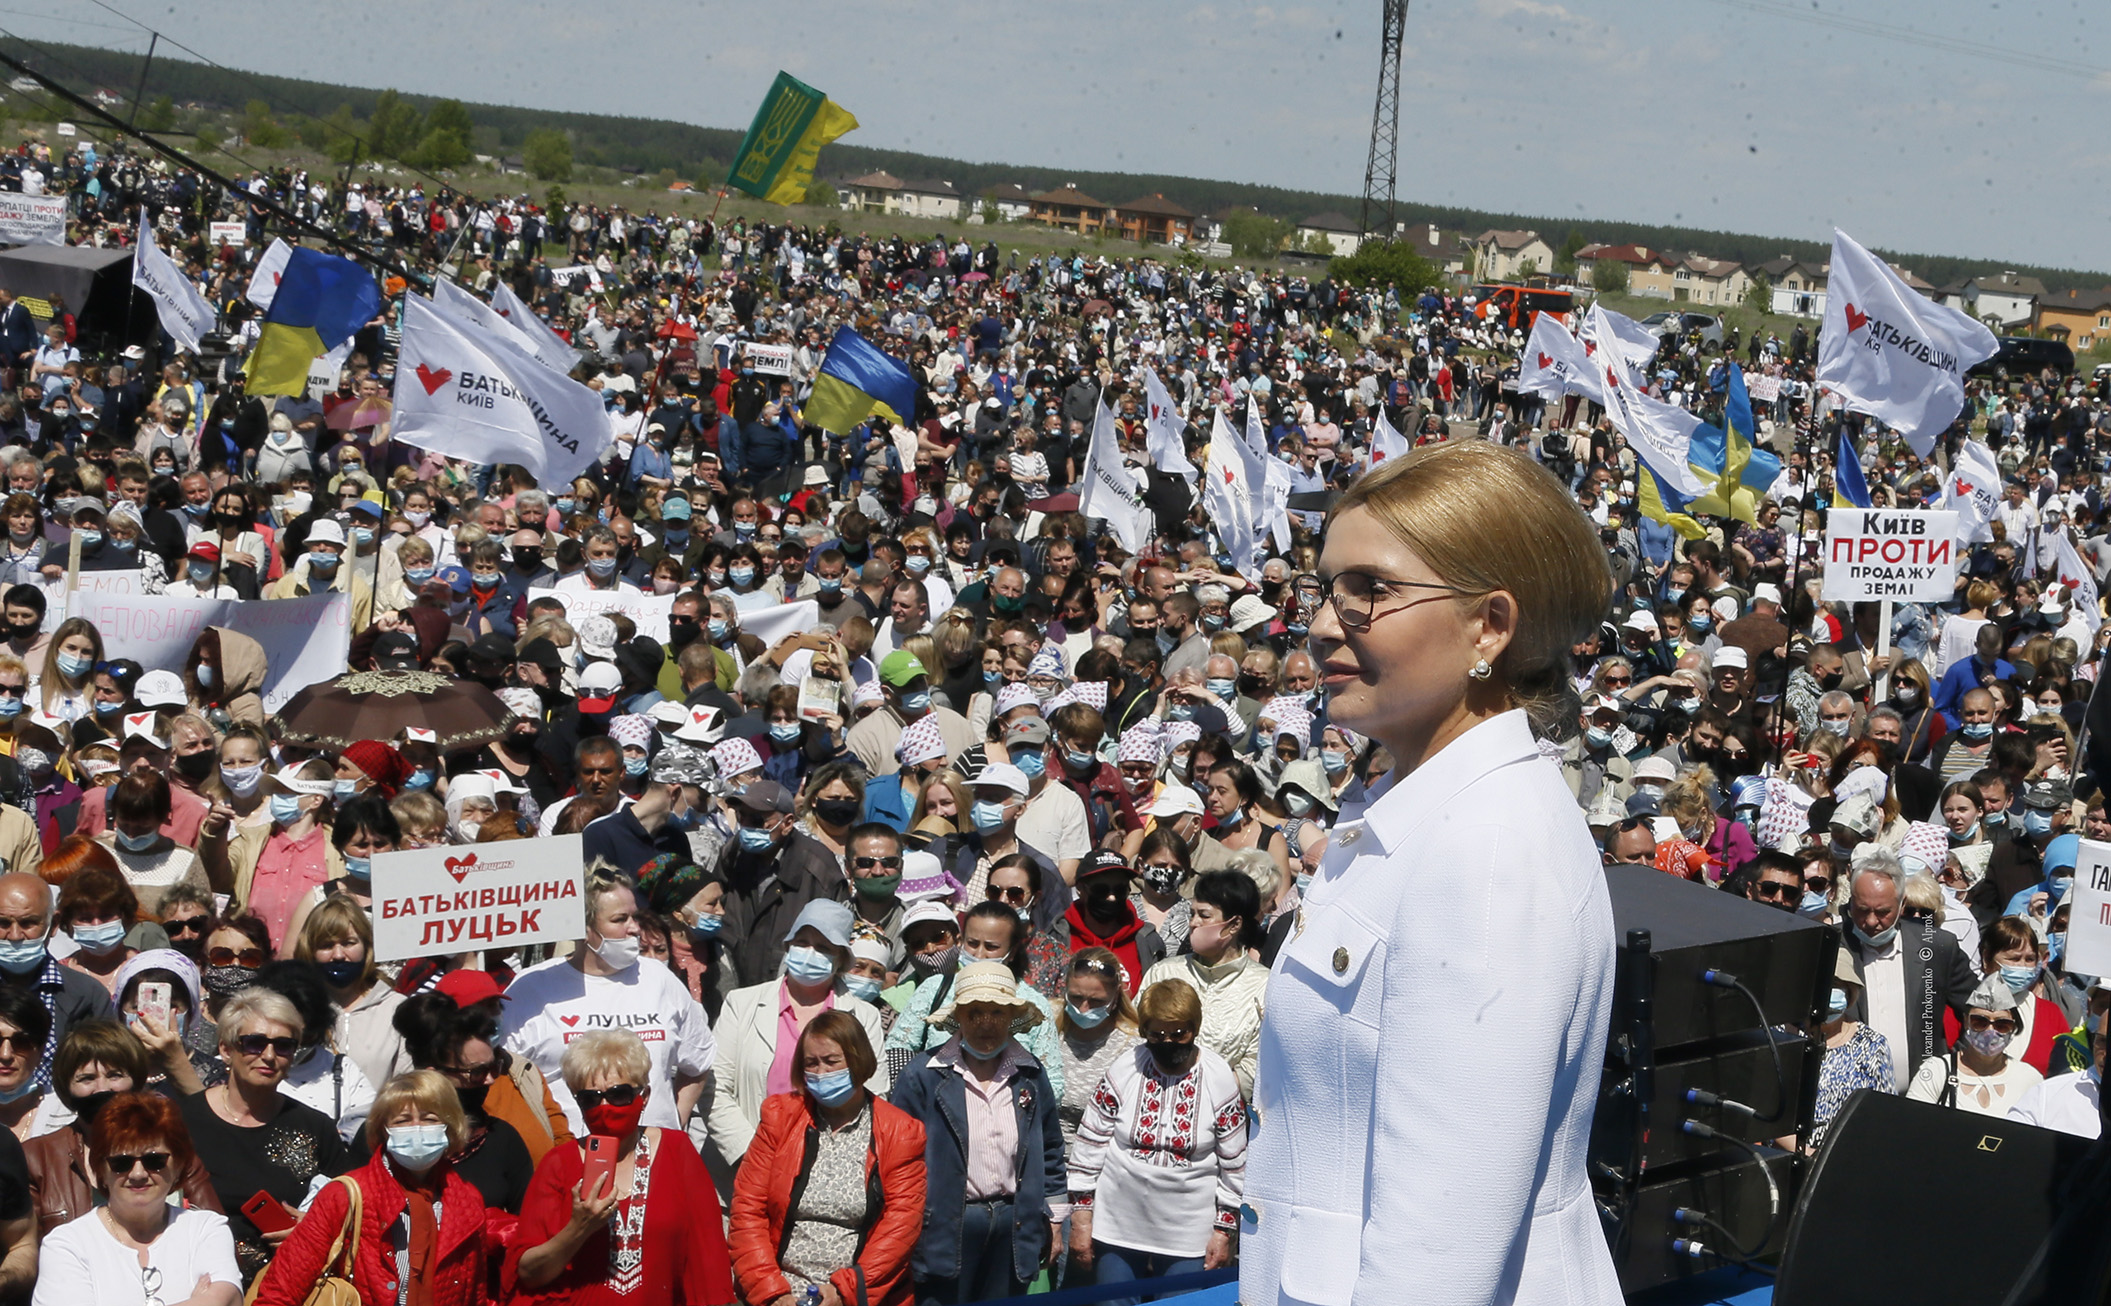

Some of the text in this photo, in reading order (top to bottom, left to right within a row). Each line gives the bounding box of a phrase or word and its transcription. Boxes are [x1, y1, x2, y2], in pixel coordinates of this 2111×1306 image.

[26, 213, 60, 224] ЗЕМЕЛЬ
[34, 205, 64, 215] ПРОТИ
[457, 391, 495, 409] КИЇВ
[459, 372, 580, 455] БАТЬКЩИНА
[1089, 454, 1140, 509] ТЬКІВЩИНА
[1831, 537, 1950, 565] ПРОТИ
[1850, 566, 1937, 580] ПРОДАЖУ
[1863, 583, 1915, 595] ЗЕМЛІ
[2090, 864, 2111, 892] ГА
[382, 879, 577, 919] БАТЬКІВЩИНА
[419, 908, 542, 946] ЛУЦЬК
[586, 1013, 662, 1028] ЛУЦЬК
